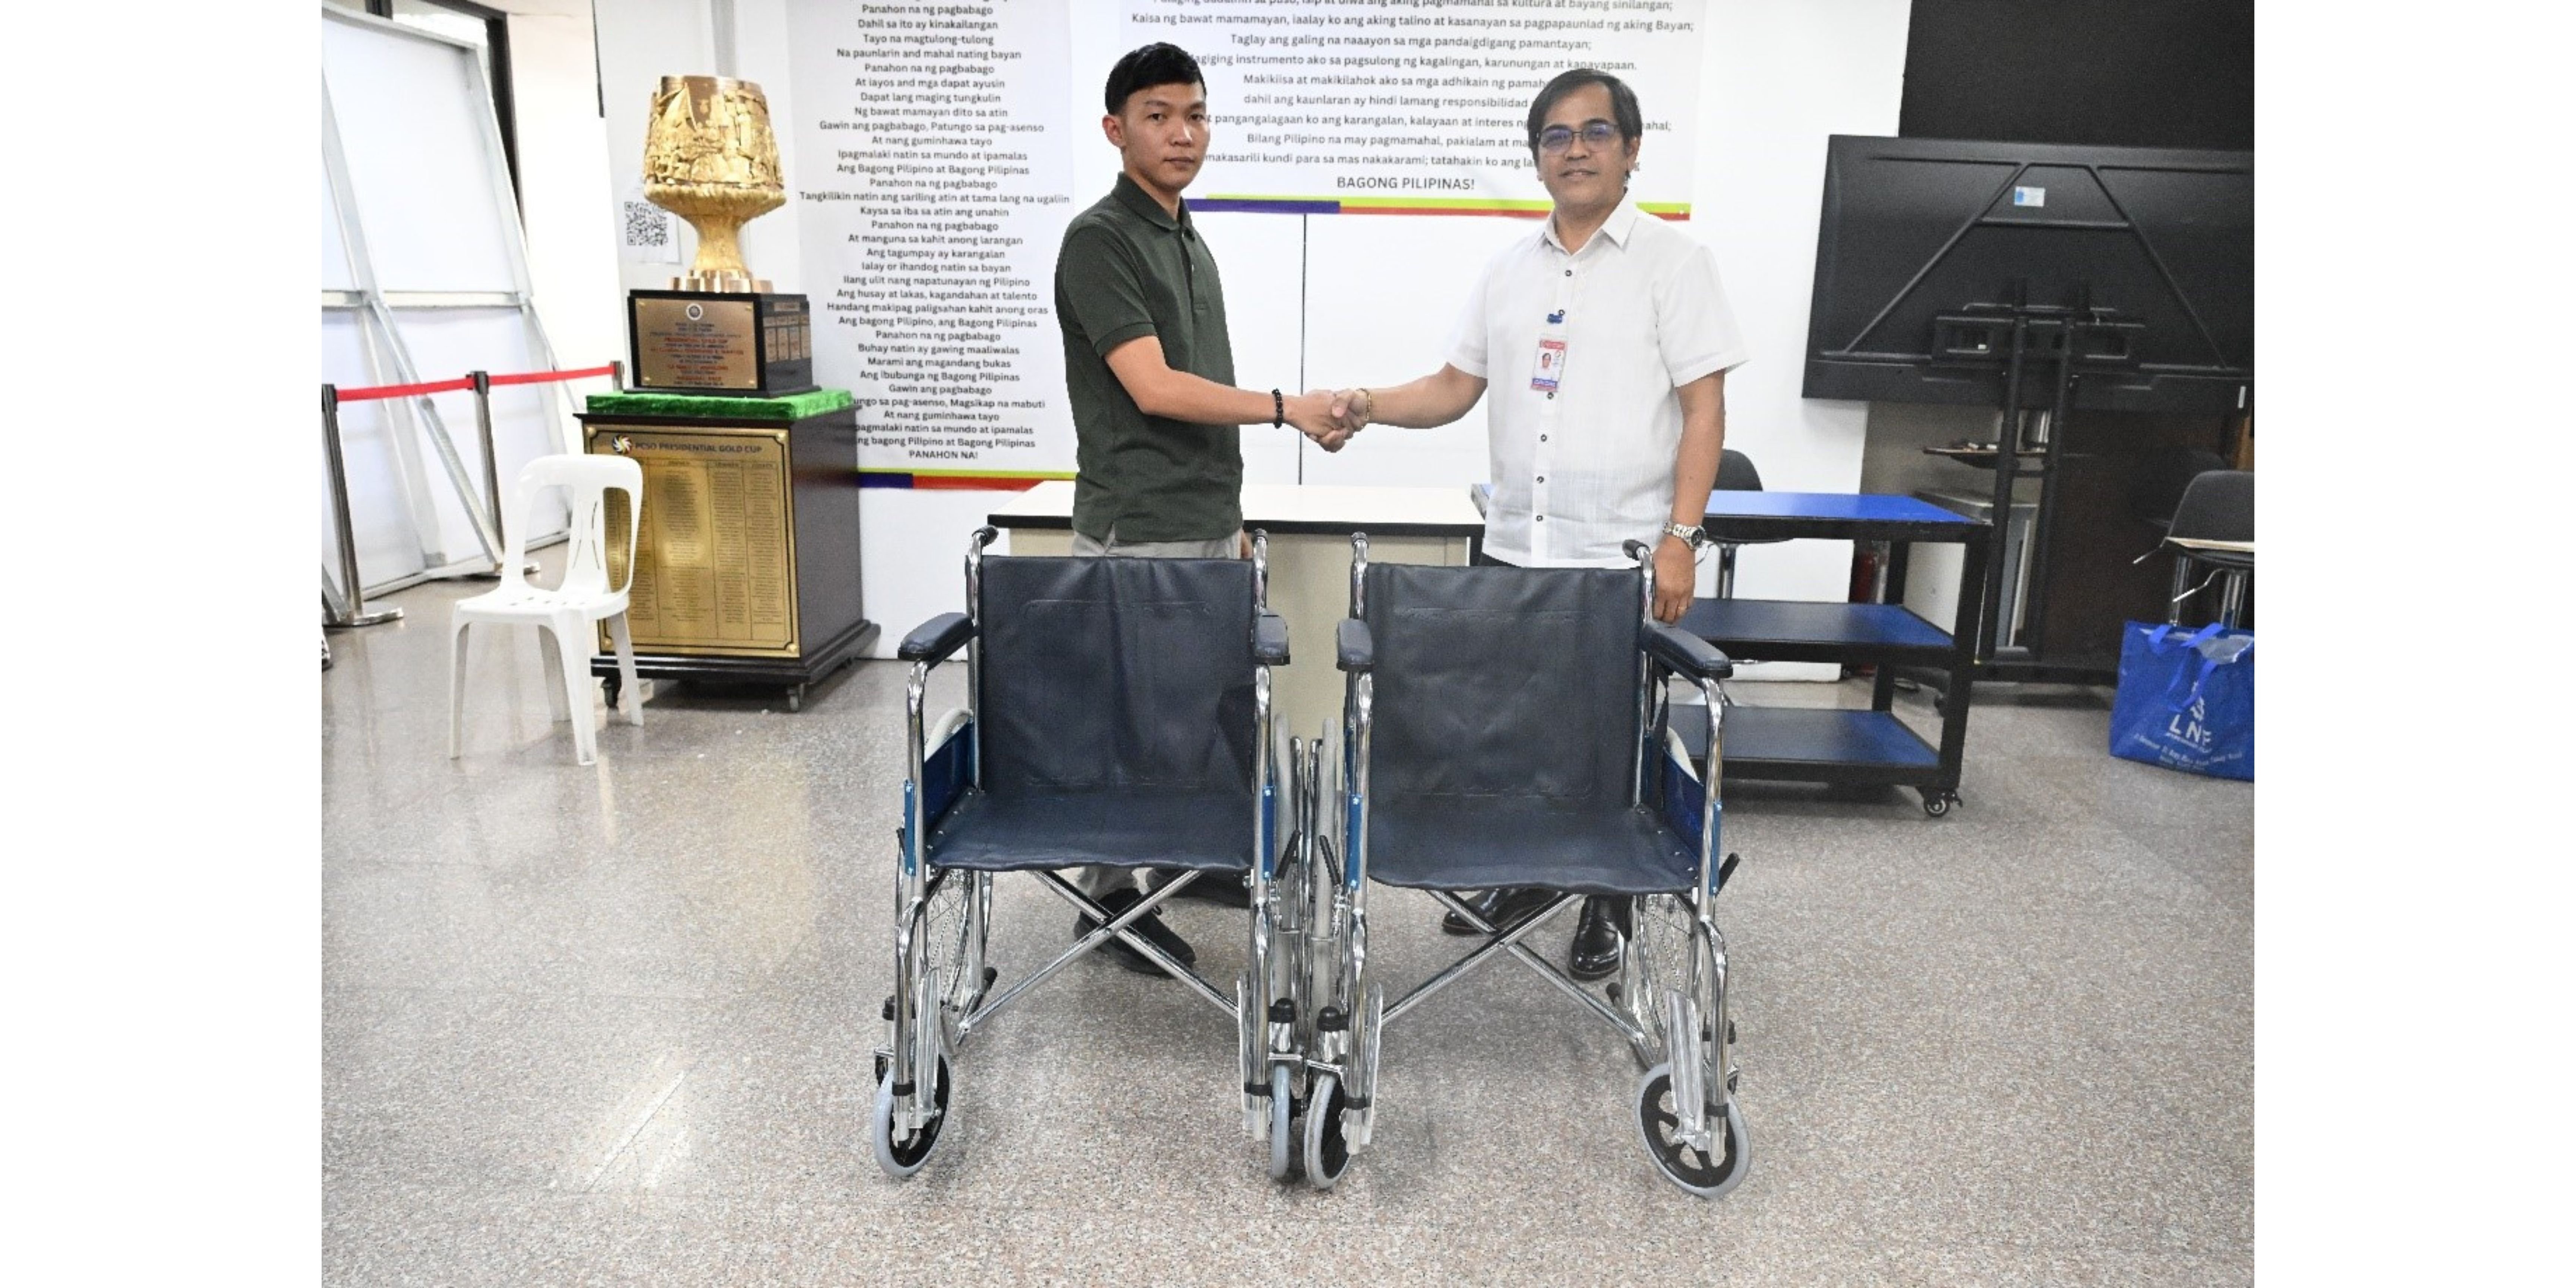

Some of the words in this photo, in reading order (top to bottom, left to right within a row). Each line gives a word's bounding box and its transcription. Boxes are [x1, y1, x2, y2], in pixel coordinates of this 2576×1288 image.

[862, 4, 906, 14] Panahon
[922, 6, 936, 16] ng
[937, 4, 994, 17] pagbabago
[1569, 0, 1609, 10] bayang
[1132, 13, 1161, 23] Kaisa
[1163, 15, 1177, 26] ng
[1179, 14, 1213, 23] bawat
[1328, 15, 1341, 25] ko
[1344, 16, 1364, 28] ang
[1366, 15, 1396, 28] aking
[1398, 15, 1431, 26] talino
[1434, 17, 1445, 26] at
[1448, 16, 1507, 29] kasanayan
[1524, 19, 1604, 31] pagpapaunlad
[1607, 22, 1620, 31] ng
[1623, 19, 1653, 32] aking
[863, 34, 887, 45] Tayo
[904, 34, 994, 47] magtulong-tulong
[1231, 34, 1266, 47] Taglay
[1269, 36, 1289, 47] ang
[1291, 34, 1325, 47] galing
[1343, 37, 1391, 48] naaayon
[1408, 37, 1432, 48] mga
[1434, 37, 1516, 50] pandaigdigang
[837, 48, 851, 57] Na
[852, 48, 900, 60] paunlarin
[902, 49, 921, 58] and
[923, 49, 954, 58] mahal
[956, 50, 989, 61] nating
[991, 49, 1022, 61] bayan
[1236, 54, 1305, 65] instrumento
[1306, 55, 1327, 64] ako
[1329, 57, 1341, 65] sa
[1344, 56, 1401, 68] pagsulong
[1403, 58, 1417, 69] ng
[1484, 57, 1550, 70] karunungan
[855, 78, 866, 86] At
[897, 78, 915, 87] and
[918, 79, 939, 89] mga
[940, 78, 970, 89] dapat
[972, 80, 1005, 90] ayusin
[1296, 76, 1308, 85] at
[1310, 75, 1376, 85] makikilahok
[1379, 76, 1399, 85] ako
[1415, 78, 1439, 89] mga
[1441, 76, 1489, 87] adhikain
[1491, 80, 1505, 90] ng
[860, 92, 890, 103] Dapat
[892, 93, 914, 104] lang
[915, 93, 952, 104] maging
[953, 93, 1001, 105] tungkulin
[1244, 95, 1271, 104] dahil
[1274, 96, 1294, 107] ang
[1296, 95, 1351, 105] kaunlaran
[1353, 98, 1367, 107] ay
[1369, 95, 1397, 105] hindi
[1400, 96, 1440, 108] lamang
[1442, 97, 1528, 108] responsibilidad
[854, 107, 868, 118] Ng
[870, 107, 900, 116] bawat
[902, 109, 950, 118] mamayan
[952, 107, 973, 117] dito
[1215, 114, 1303, 127] pangangalagaan
[1306, 114, 1319, 124] ko
[1322, 116, 1342, 127] ang
[1410, 116, 1459, 128] kalayaan
[1461, 118, 1472, 127] at
[1475, 118, 1514, 127] interes
[872, 136, 883, 145] At
[885, 137, 910, 147] nang
[911, 136, 968, 148] guminhawa
[969, 138, 992, 148] tayo
[1247, 134, 1281, 146] Bilang
[1284, 134, 1326, 145] Pilipino
[1344, 137, 1368, 147] may
[1446, 136, 1496, 148] pakialam
[1498, 138, 1509, 147] at
[1263, 153, 1293, 163] kundi
[1295, 155, 1320, 165] para
[1431, 155, 1483, 166] tatahakin
[1485, 157, 1498, 166] ko
[1500, 159, 1521, 170] ang
[837, 164, 856, 175] Ang
[858, 164, 895, 175] Bagong
[896, 164, 934, 175] Pilipino
[948, 165, 985, 176] Bagong
[988, 165, 1030, 176] Pilipinas
[1337, 177, 1398, 189] BAGONG
[859, 206, 889, 217] Kaysa
[903, 206, 919, 215] iba
[933, 207, 953, 216] atin
[954, 209, 973, 219] ang
[975, 208, 1009, 217] unahin
[866, 248, 886, 259] Ang
[887, 249, 936, 260] tagumpay
[938, 250, 949, 260] ay
[951, 249, 1005, 261] karangalan
[836, 289, 856, 300] Ang
[857, 289, 886, 300] husay
[929, 290, 988, 302] kagandahan
[1002, 291, 1038, 300] talento
[838, 316, 858, 327] Ang
[859, 316, 895, 328] bagong
[938, 319, 956, 329] ang
[957, 318, 995, 329] Bagong
[996, 319, 1038, 329] Pilipinas
[867, 357, 904, 366] Marami
[905, 359, 924, 369] ang
[925, 358, 981, 370] magandang
[982, 359, 1012, 368] bukas
[888, 383, 918, 393] Gawin
[920, 386, 938, 395] ang
[939, 385, 992, 396] pagbabago
[719, 445, 742, 453] GOLD
[908, 450, 959, 459] PANAHON
